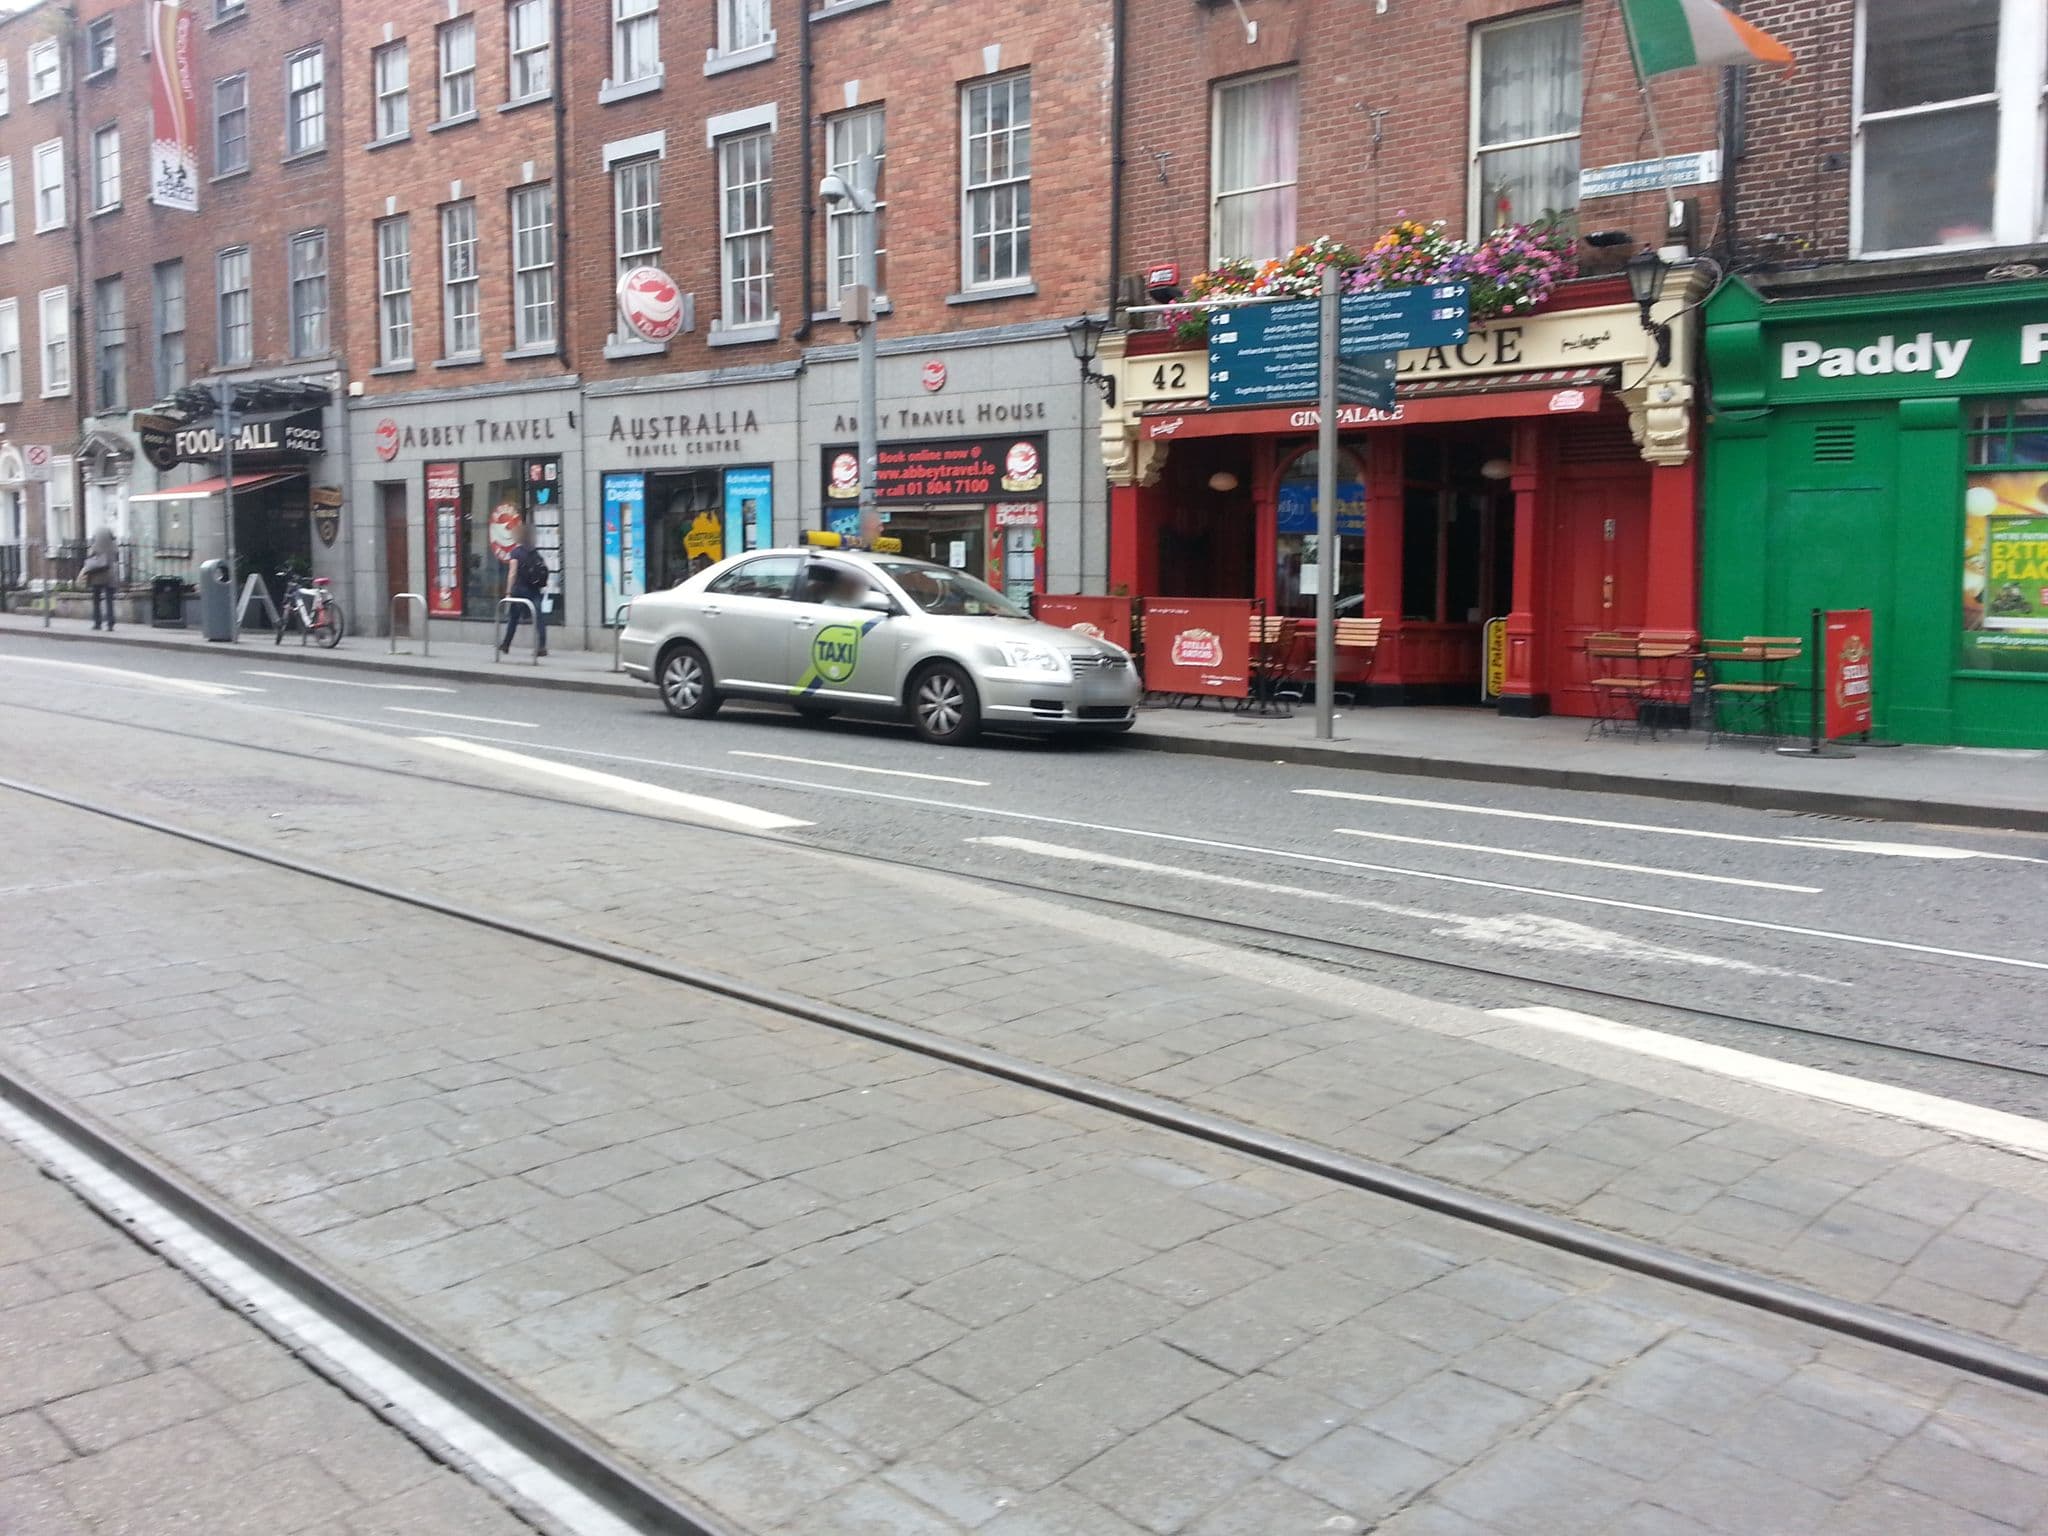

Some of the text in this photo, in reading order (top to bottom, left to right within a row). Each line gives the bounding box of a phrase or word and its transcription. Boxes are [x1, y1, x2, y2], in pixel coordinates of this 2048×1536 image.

[1396, 326, 1522, 373] ACE
[1781, 332, 1972, 379] Paddy
[1152, 363, 1186, 390] 42
[609, 409, 759, 441] AUSTRALIA
[834, 402, 1046, 432] ABY TRAVEL HOUSE
[1290, 410, 1322, 427] GIN
[285, 427, 321, 440] FOOD
[403, 418, 555, 448] ABBEY TRAVEL
[286, 438, 321, 451] HALL
[626, 439, 742, 457] TRAVEL CENTRE
[879, 451, 905, 464] Book
[908, 449, 941, 462] online
[944, 449, 968, 460] now
[876, 461, 996, 483] ww.abbeytravel.ie
[428, 487, 460, 500] DEALS
[607, 488, 642, 502] Deals
[907, 482, 923, 496] 01
[955, 478, 989, 494] 7100
[996, 512, 1038, 526] Deals
[817, 640, 854, 664] TAXI
